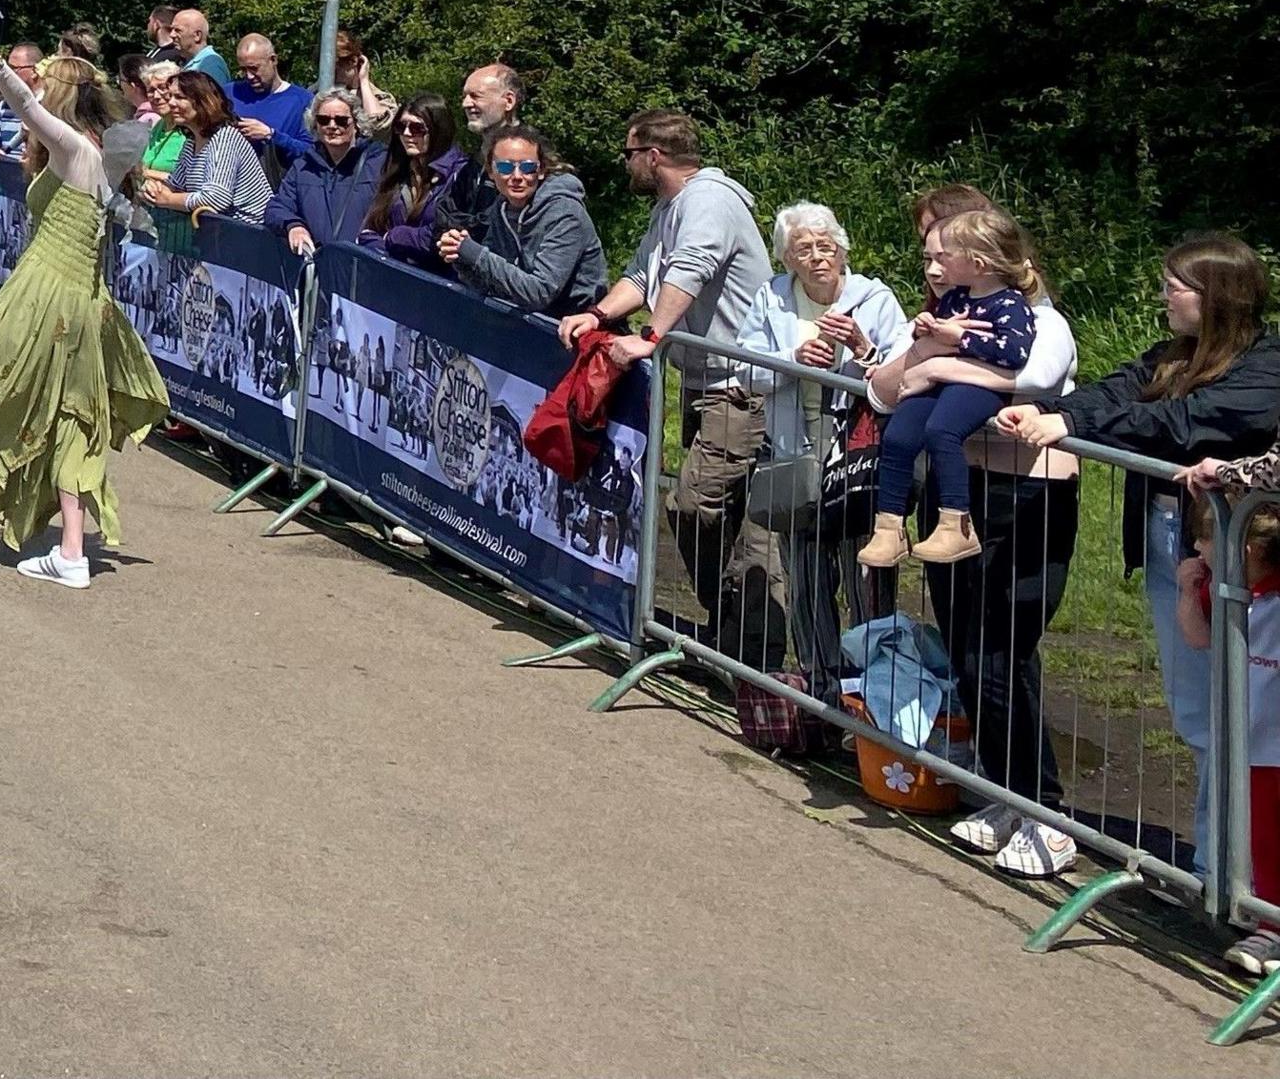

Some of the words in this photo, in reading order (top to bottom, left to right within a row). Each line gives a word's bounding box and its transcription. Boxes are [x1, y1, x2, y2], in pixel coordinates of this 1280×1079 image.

[443, 364, 488, 416] Stilton
[437, 397, 487, 450] Cheese
[381, 471, 528, 567] stiltoncheeserollingfestival.com
